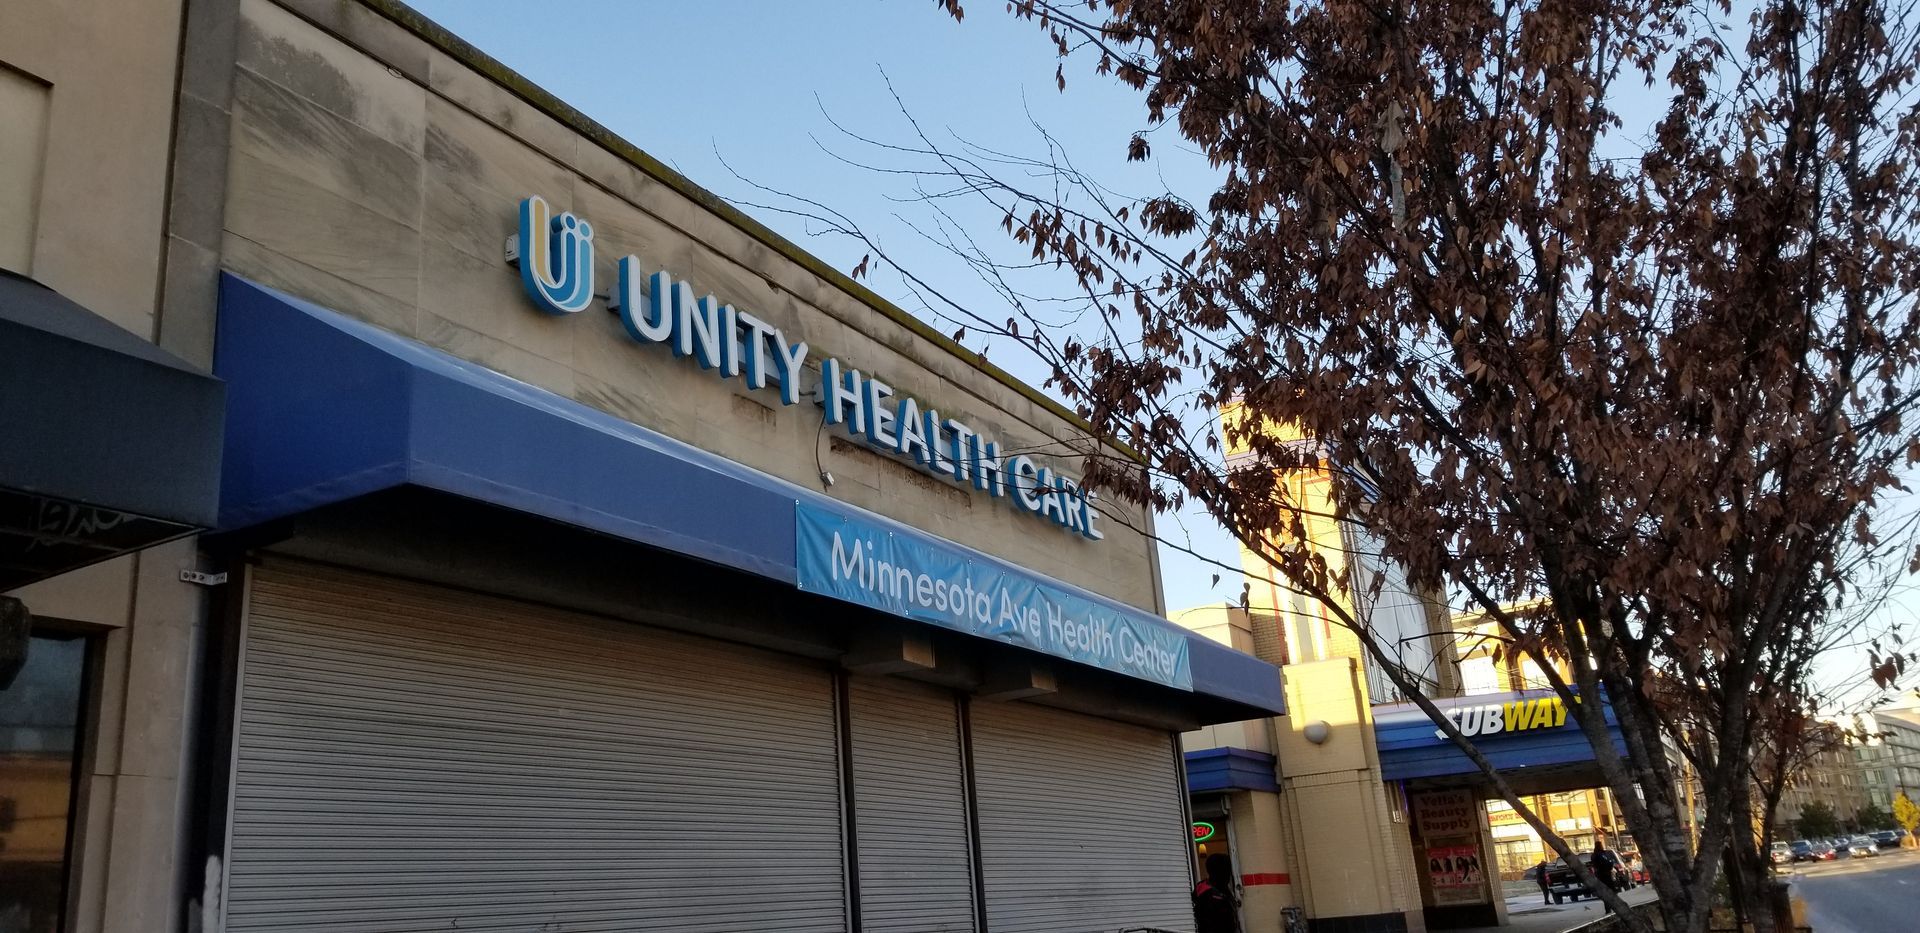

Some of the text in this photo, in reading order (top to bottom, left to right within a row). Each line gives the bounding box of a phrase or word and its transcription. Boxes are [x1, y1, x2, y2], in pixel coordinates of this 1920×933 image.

[619, 255, 1104, 541] UNITY HEALTH CARE
[831, 531, 1177, 678] Minnesota Ave Health Center
[1420, 806, 1469, 819] Beauty
[1423, 817, 1472, 831] Supply
[1193, 826, 1210, 837] PEN
